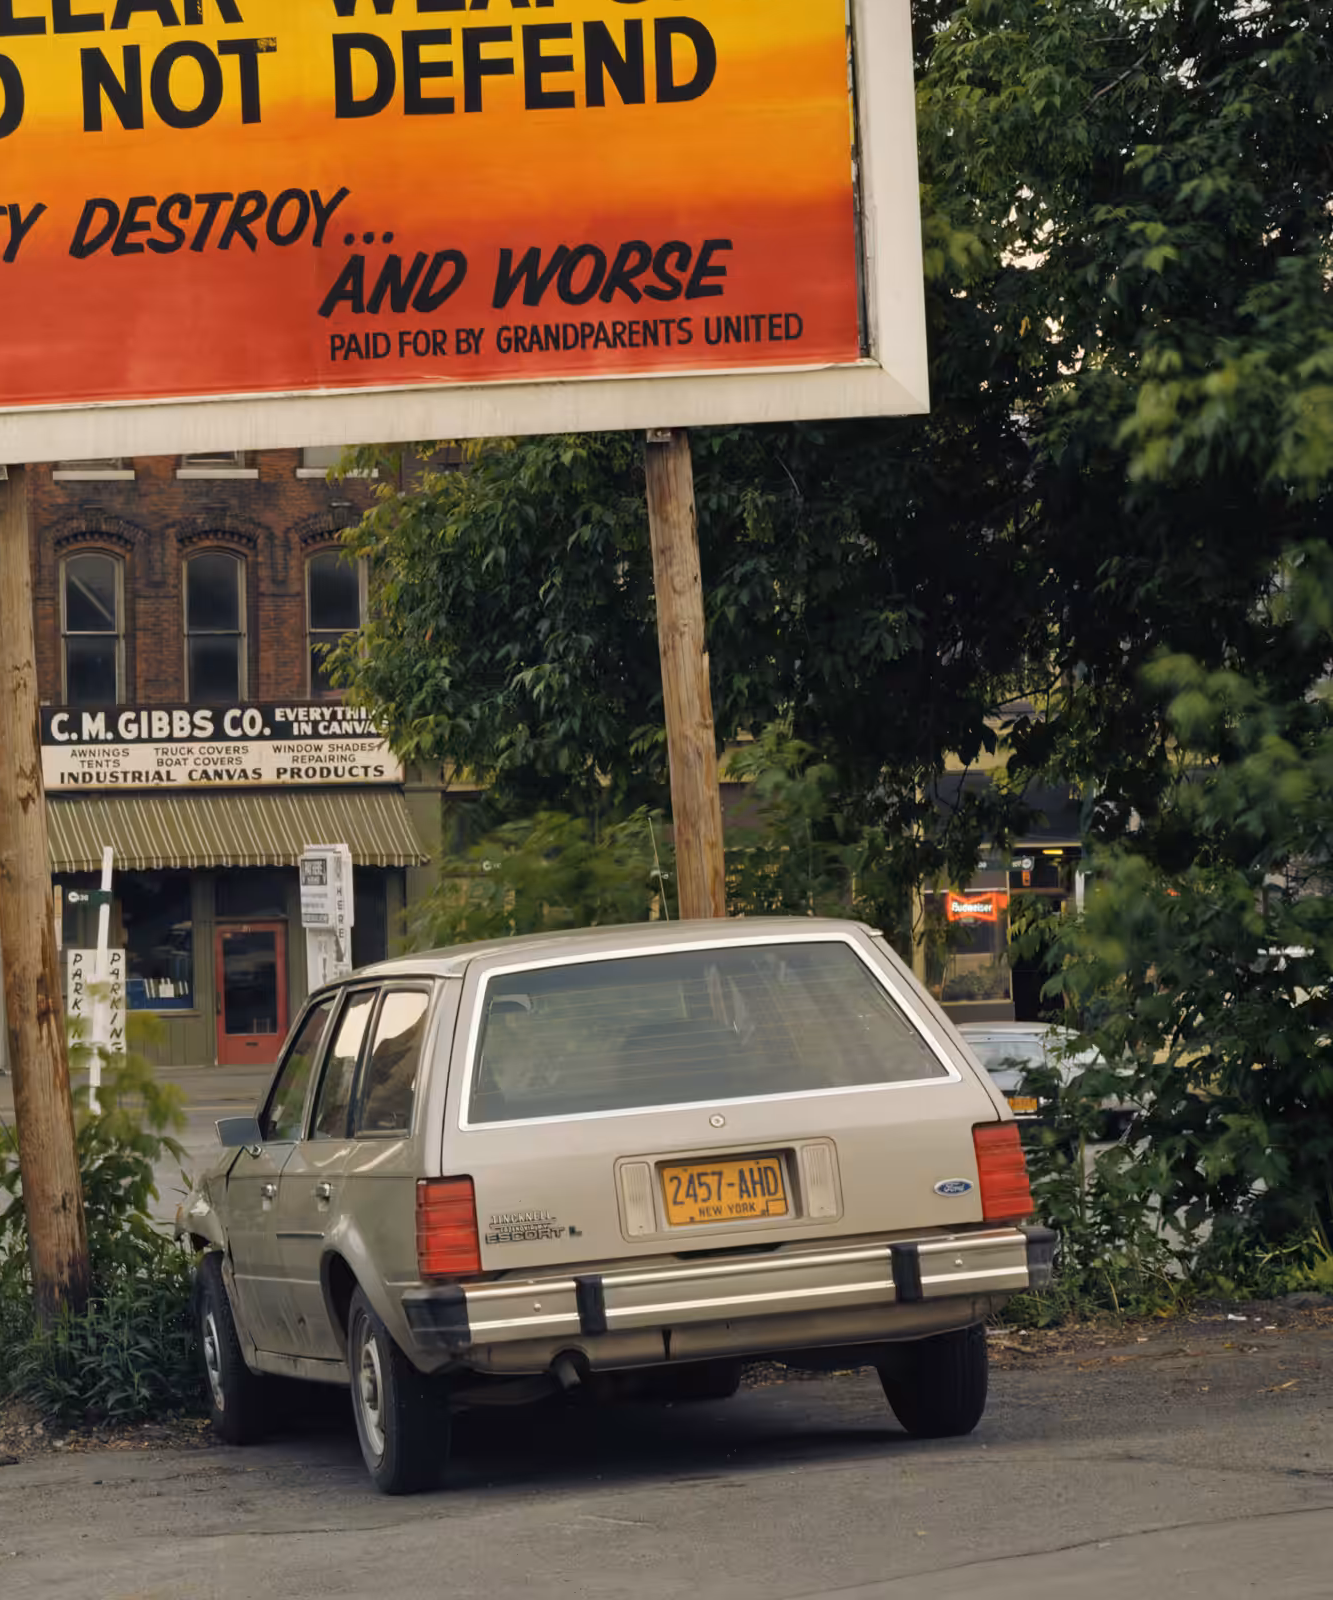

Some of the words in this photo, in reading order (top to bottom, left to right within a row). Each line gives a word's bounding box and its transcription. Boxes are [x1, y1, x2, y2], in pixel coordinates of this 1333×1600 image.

[80, 37, 278, 134] NOT
[331, 15, 718, 120] DEFEND
[68, 187, 396, 261] DESTROY...
[318, 251, 467, 319] AND
[491, 238, 732, 311] WORSE
[330, 331, 391, 363] PAID
[395, 329, 447, 360] FOR
[454, 327, 483, 357] BY
[494, 319, 693, 356] GRANDPARENTS
[702, 312, 804, 348] UNITED
[117, 709, 215, 740] GIBBS
[222, 708, 271, 737] CO.
[292, 722, 312, 736] IN
[70, 747, 130, 758] AWNINGS
[154, 746, 194, 756] TRUCK
[198, 745, 249, 755] COVERS
[272, 743, 324, 754] WINDOW
[80, 758, 120, 769] TENTS
[157, 757, 190, 767] BOAT
[193, 755, 243, 766] COVERS
[292, 753, 356, 764] REPAIRING
[60, 769, 177, 784] INDUSTRIAL
[188, 767, 263, 781] CANVAS
[276, 764, 385, 779] PRODUCTS
[669, 1164, 778, 1206] 2457-AHD
[942, 1182, 965, 1193] Ford
[698, 1205, 722, 1217] NEW
[732, 1201, 757, 1216] YORK
[485, 1228, 564, 1244] ESCORT
